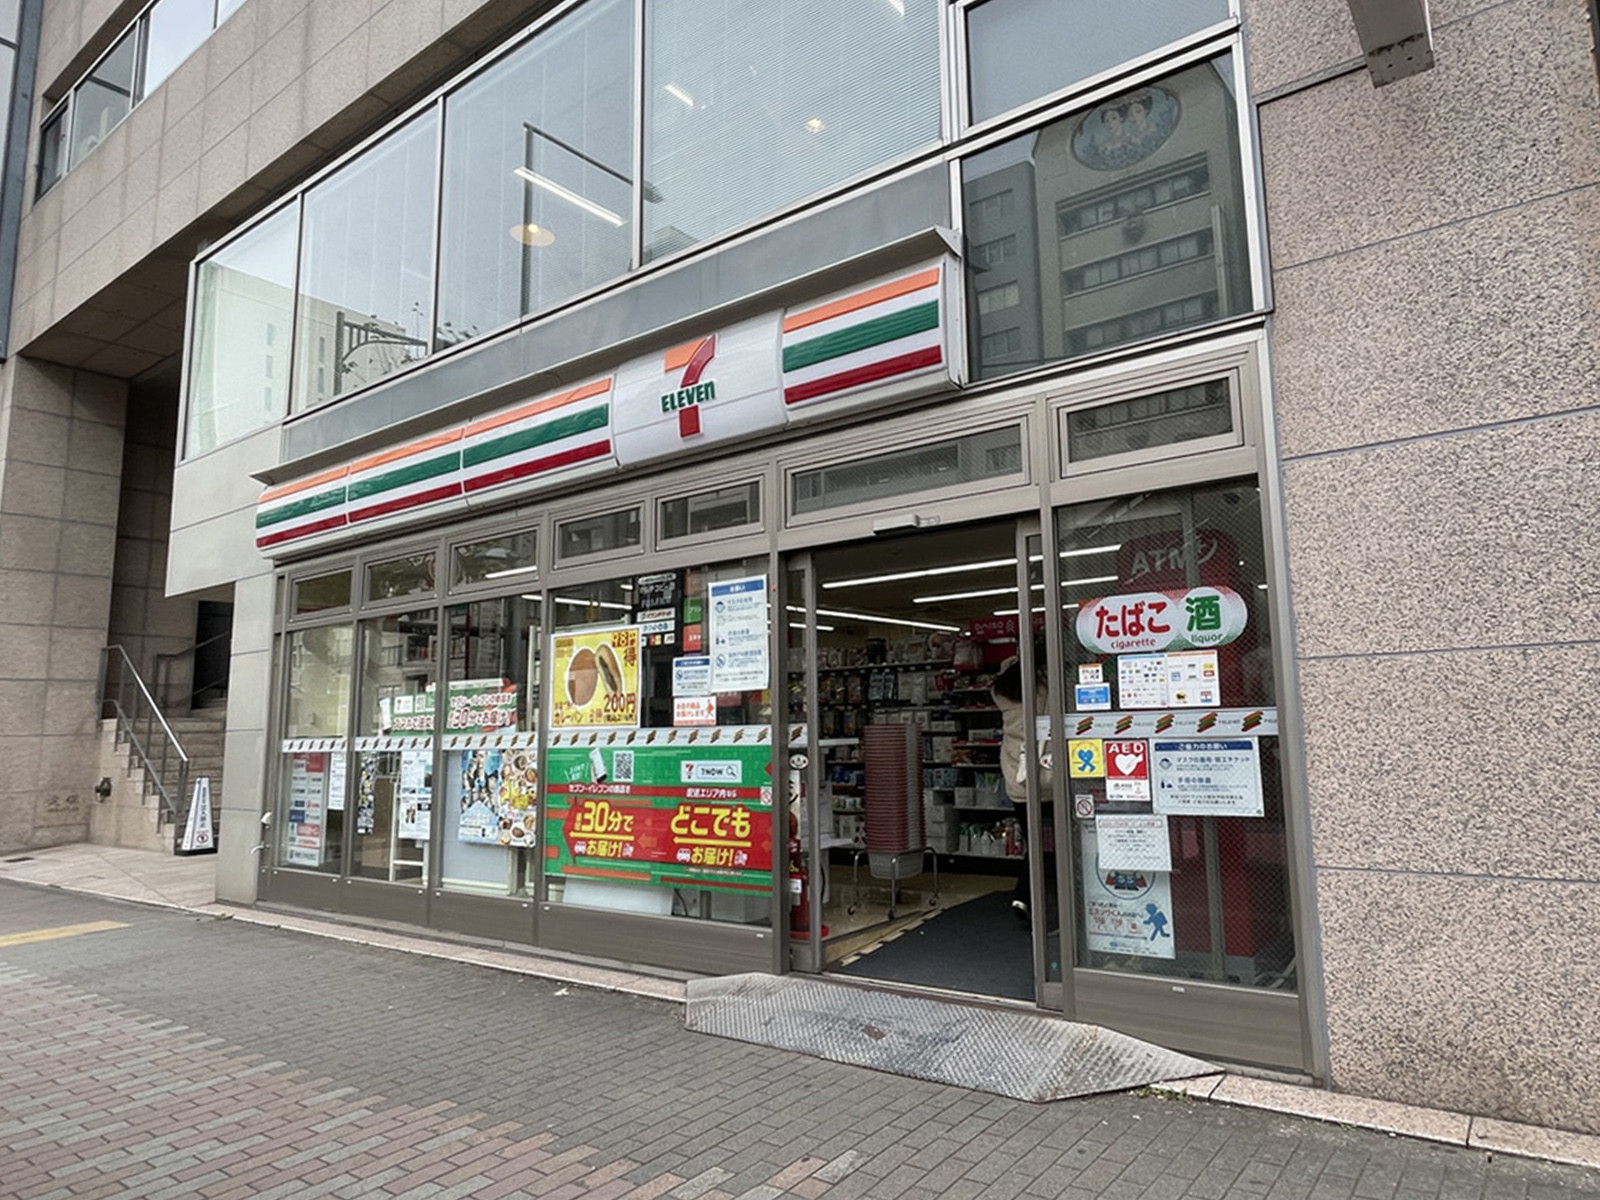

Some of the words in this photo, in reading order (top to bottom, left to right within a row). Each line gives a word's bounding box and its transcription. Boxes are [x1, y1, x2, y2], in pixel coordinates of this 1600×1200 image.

[1096, 601, 1170, 638] たばこ
[1185, 596, 1221, 631] 酒
[1111, 638, 1156, 649] cigarette
[1191, 632, 1223, 643] liquor
[604, 692, 636, 713] 200円
[1108, 743, 1144, 753] AED
[670, 805, 751, 838] どこでも
[587, 840, 623, 858] お届け!
[691, 847, 734, 866] お届け!
